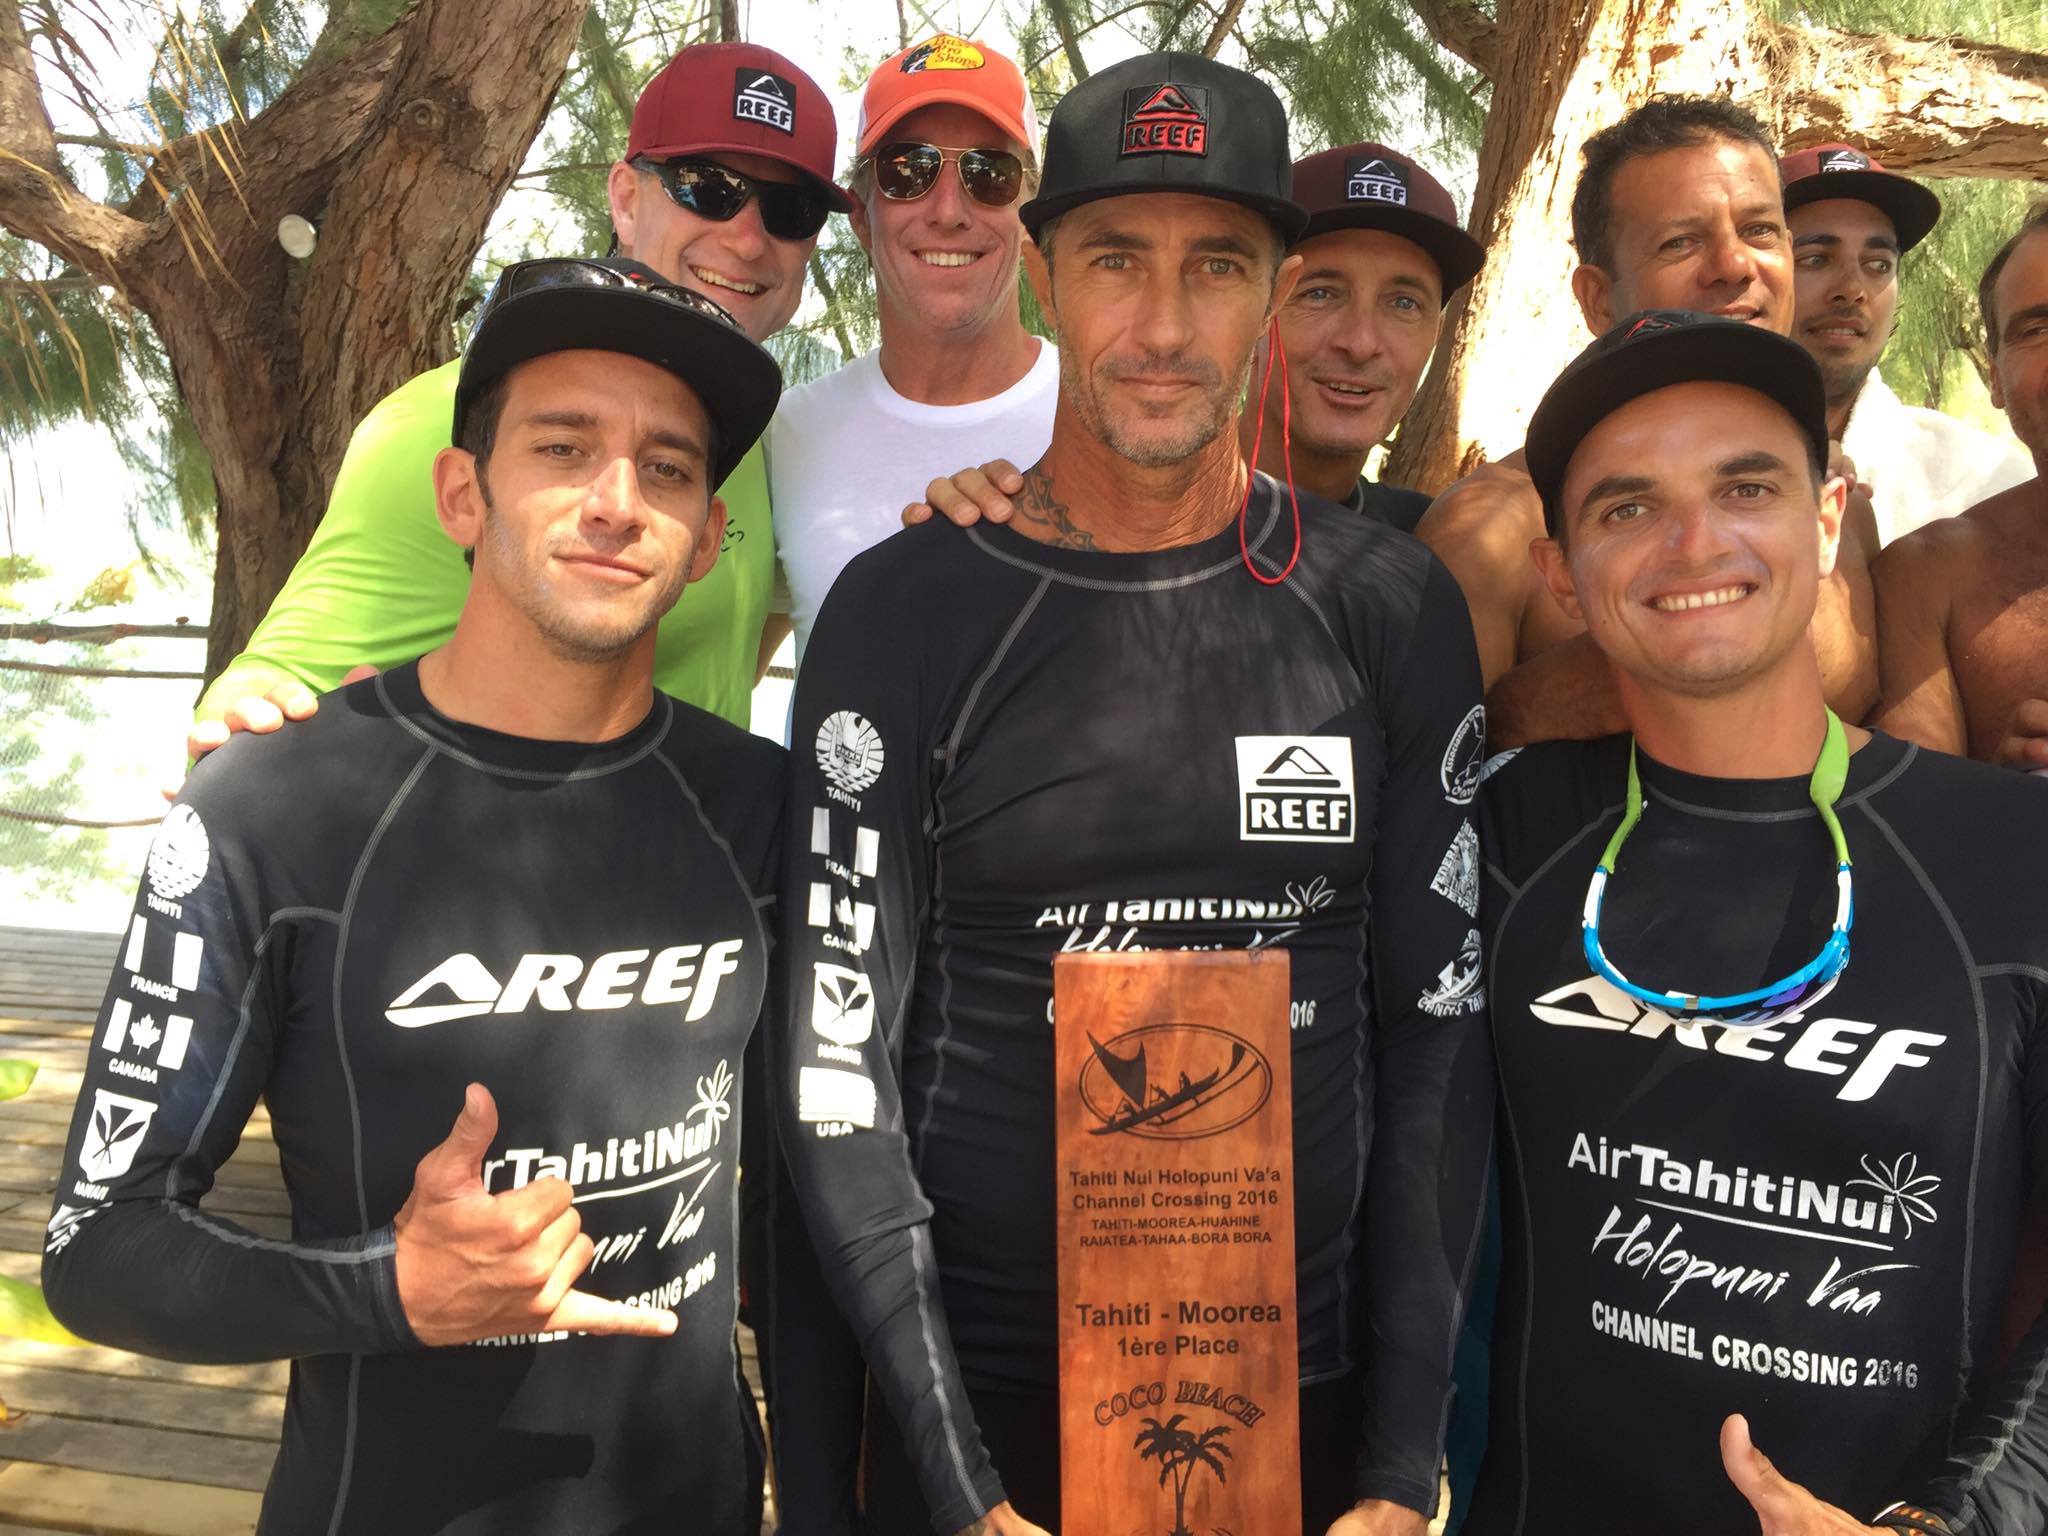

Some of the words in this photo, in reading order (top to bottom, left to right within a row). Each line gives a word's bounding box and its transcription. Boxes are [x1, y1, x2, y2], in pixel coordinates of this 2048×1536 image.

[739, 98, 791, 126] REEF
[1128, 124, 1202, 149] REEF
[1350, 182, 1405, 202] REEF
[825, 786, 862, 813] TAHITI
[1251, 798, 1348, 831] REEF
[147, 893, 183, 920] TAHITI
[130, 974, 179, 1003] FRANCE
[494, 938, 743, 1022] REEF
[1290, 1000, 1317, 1029] 016
[108, 1058, 159, 1084] CANADA
[816, 1122, 855, 1138] USA
[1070, 1170, 1117, 1187] Tahiti
[1123, 1169, 1151, 1186] Nui
[1158, 1167, 1238, 1188] Holopuni
[1244, 1167, 1281, 1182] Va'a
[1568, 1132, 1896, 1235] AirTahitiNui
[1073, 1193, 1146, 1210] Channel
[1151, 1191, 1232, 1209] Crossing
[1237, 1190, 1279, 1206] 2016
[1092, 1216, 1261, 1231] TAHITI-MOOREA-HUAHINE
[1080, 1232, 1229, 1247] RAIATEA-TAHAA-BORA
[1234, 1232, 1273, 1244] BORA
[1591, 1206, 1790, 1313] Holopuni
[1806, 1256, 1921, 1317] Vaa
[1076, 1303, 1151, 1327] Tahiti
[1178, 1301, 1282, 1324] Moorea
[1117, 1337, 1168, 1357] 1ère
[1175, 1335, 1240, 1356] Place
[1592, 1300, 1703, 1361] CHANNEL
[1712, 1335, 1858, 1386] CROSSING
[1863, 1358, 1918, 1390] 2016
[1094, 1381, 1167, 1427] COCO
[1174, 1380, 1266, 1428] BEACH
